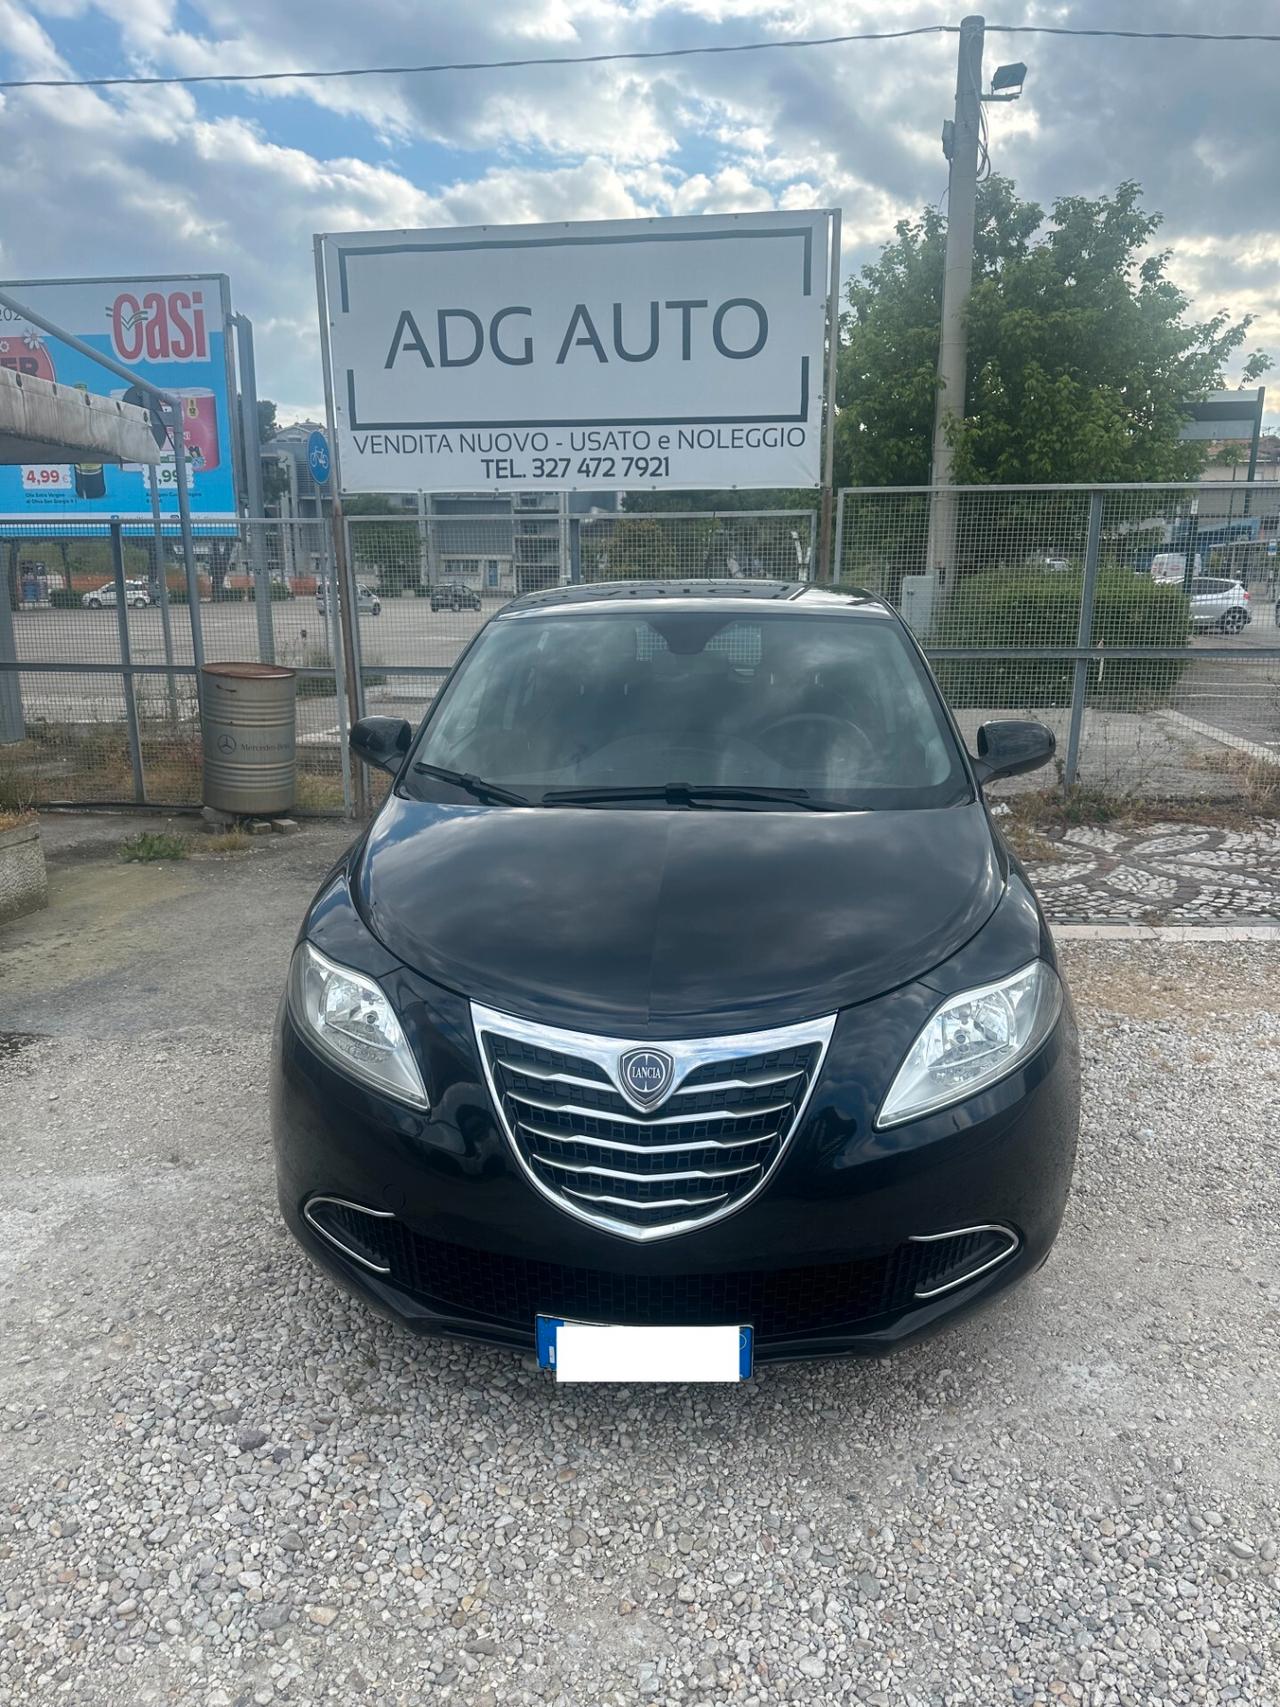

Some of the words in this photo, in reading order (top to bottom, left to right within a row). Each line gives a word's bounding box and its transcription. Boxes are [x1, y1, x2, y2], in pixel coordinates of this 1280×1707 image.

[112, 291, 206, 360] Oasi
[384, 305, 534, 369] ADG
[555, 298, 769, 364] AUTO
[353, 434, 453, 455] VENDITA
[460, 431, 549, 453] NUOVO
[570, 430, 650, 451] USATO
[657, 435, 671, 450] e
[678, 427, 806, 450] NOLEGGIO
[26, 469, 60, 485] 4,99
[481, 459, 527, 479] TEL.
[532, 458, 571, 478] 327
[577, 457, 616, 478] 472
[621, 456, 670, 477] 7921
[632, 1066, 661, 1079] LANCIA
